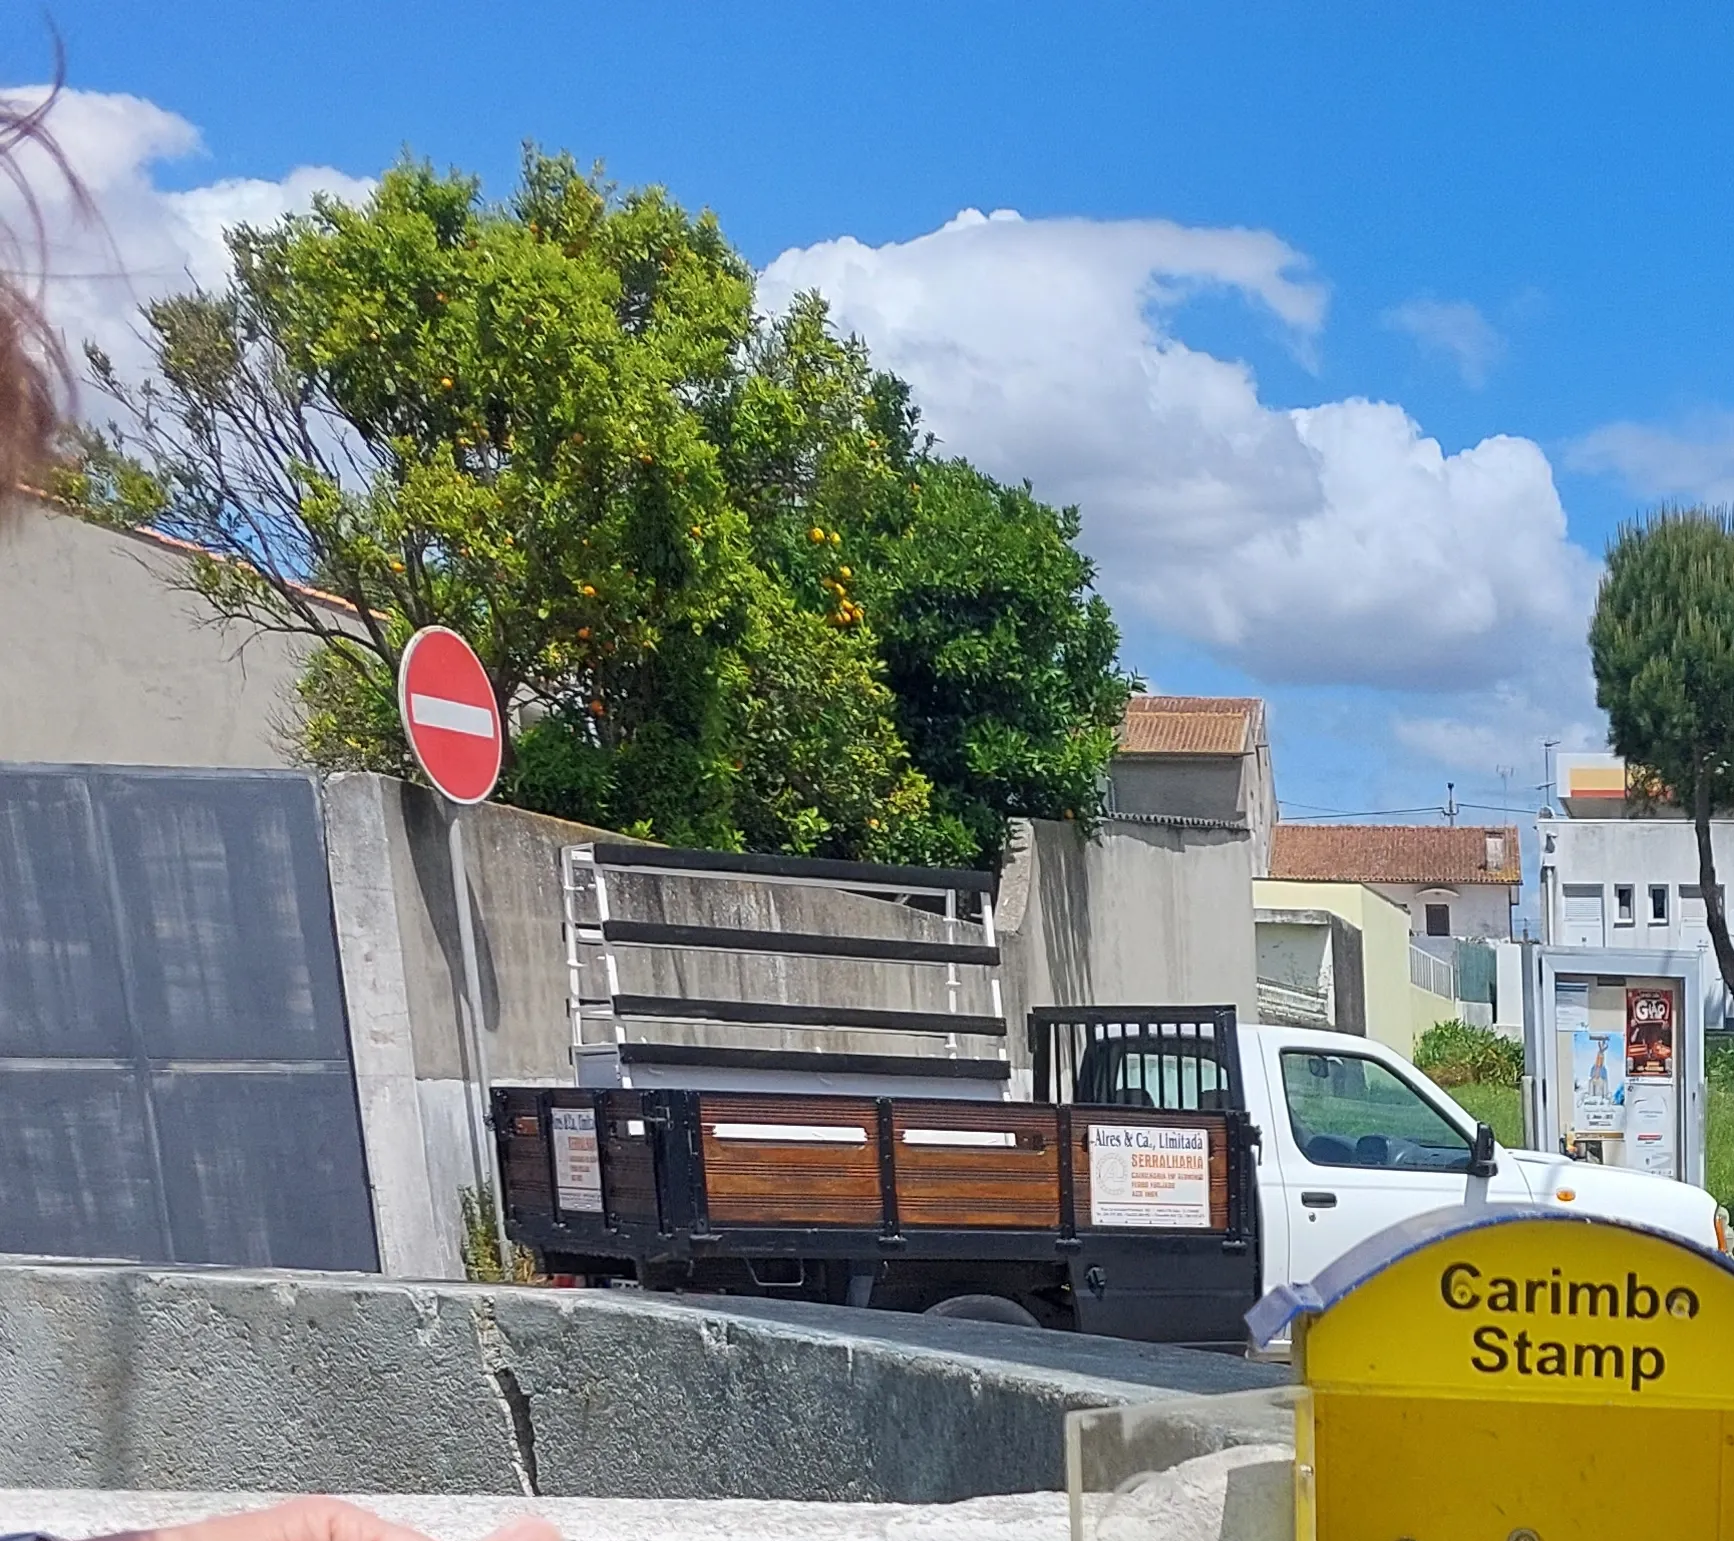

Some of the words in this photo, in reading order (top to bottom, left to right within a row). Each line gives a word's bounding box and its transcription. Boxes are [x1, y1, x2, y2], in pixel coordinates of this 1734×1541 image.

[1124, 1130, 1133, 1147] &
[1159, 1131, 1203, 1150] Limitada
[1131, 1153, 1203, 1170] SERRALHARIA
[1440, 1261, 1700, 1321] Carimbo
[1471, 1325, 1666, 1391] Stamp
